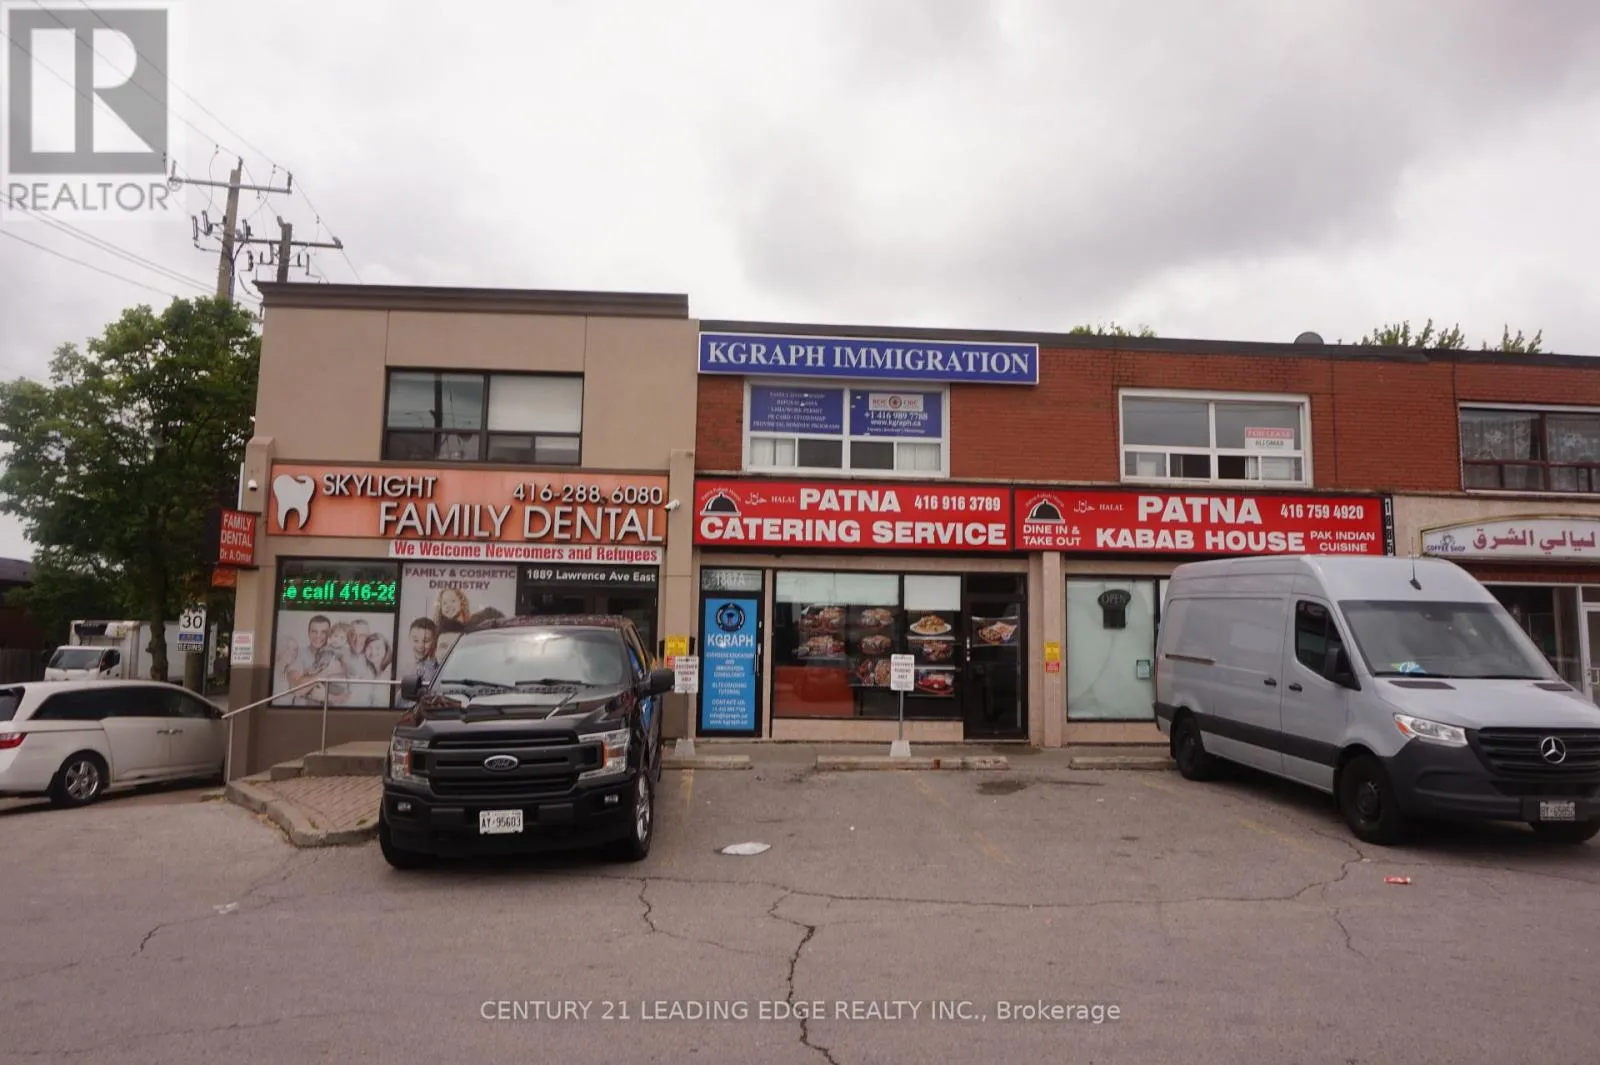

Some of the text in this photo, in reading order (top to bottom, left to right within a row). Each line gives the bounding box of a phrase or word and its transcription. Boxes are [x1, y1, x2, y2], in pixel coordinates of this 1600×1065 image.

[708, 342, 1029, 374] KGRAPH IMMIGRATION
[322, 473, 438, 498] SKYLIGHT
[799, 487, 901, 512] PATNA
[914, 495, 1001, 511] 416 916 3789
[1138, 496, 1263, 524] PATNA
[1280, 504, 1364, 519] 416 759 4920
[223, 513, 252, 531] FAMILY
[380, 501, 663, 541] FAMILY DENTAL
[221, 529, 252, 547] DENTAL
[700, 517, 1007, 546] CATERING SERVICE
[1023, 525, 1080, 535] DINE IN &
[1310, 531, 1376, 541] PAK INDIAN
[1023, 536, 1082, 546] TAKE OUT
[1096, 527, 1306, 552] KABAB HOUSE
[1320, 543, 1368, 552] CUISINE
[1473, 528, 1534, 550] الشرق
[394, 541, 657, 563] We Welcome Newcomers and Refugees
[1426, 544, 1466, 552] COFFEE SHOP
[405, 568, 516, 578] FAMILY & COSMETIC
[527, 570, 656, 582] 1889 Lawrence Ave East
[302, 581, 334, 600] call
[429, 580, 491, 589] DENTISTRY
[182, 615, 203, 629] 30
[707, 633, 753, 647] KGRAPH
